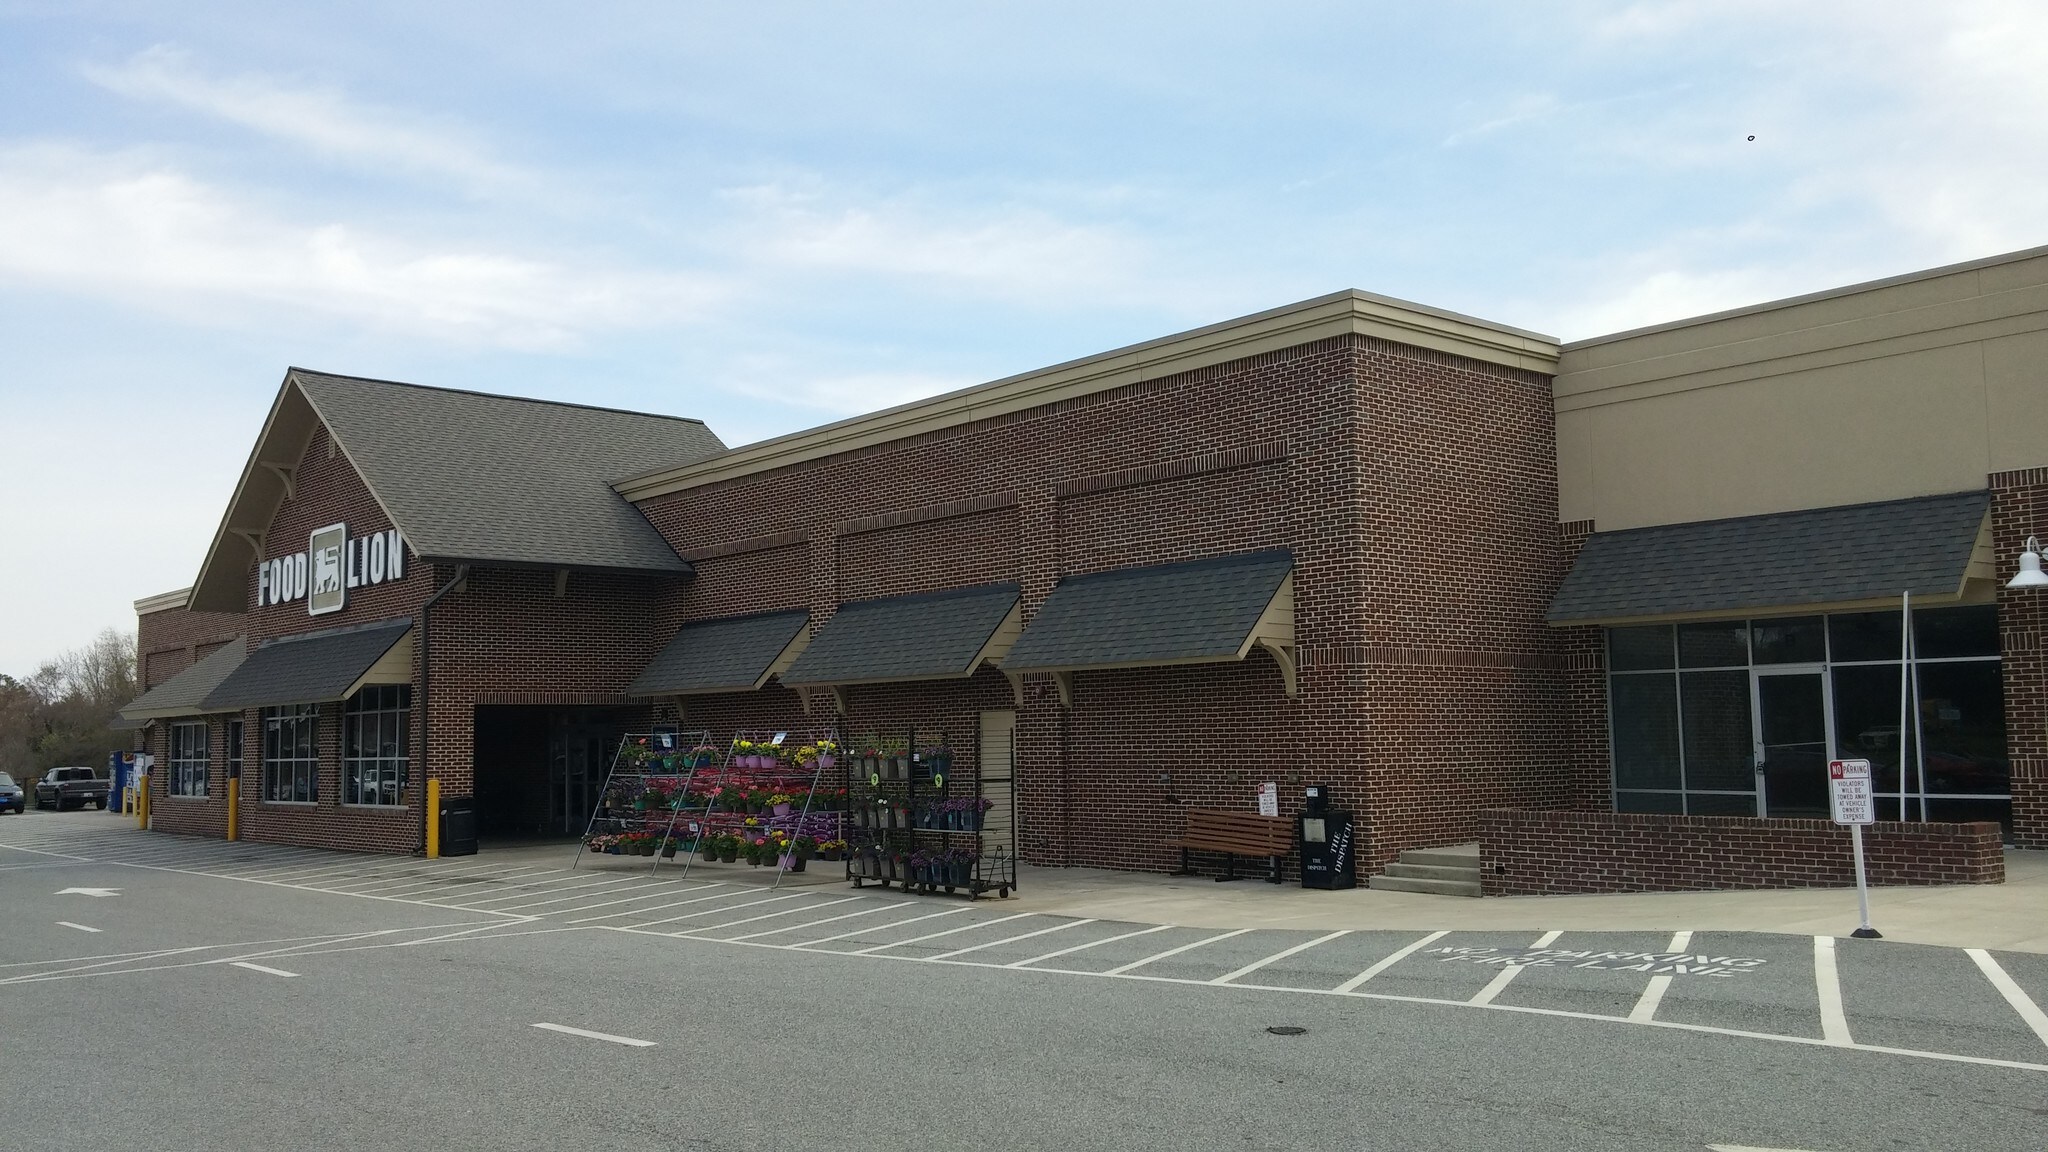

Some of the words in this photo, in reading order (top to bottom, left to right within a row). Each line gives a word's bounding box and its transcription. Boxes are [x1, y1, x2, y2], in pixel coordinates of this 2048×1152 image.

[258, 552, 307, 607] FOOD
[347, 529, 403, 588] LION
[1832, 764, 1842, 775] NO
[1843, 764, 1867, 774] PARKING
[1330, 831, 1341, 854] THE
[1334, 822, 1353, 873] DISPATCH
[1423, 947, 1499, 955] NO
[1524, 949, 1767, 968] PARKING
[1438, 954, 1576, 967] FIRE
[1573, 959, 1754, 977] LANE
